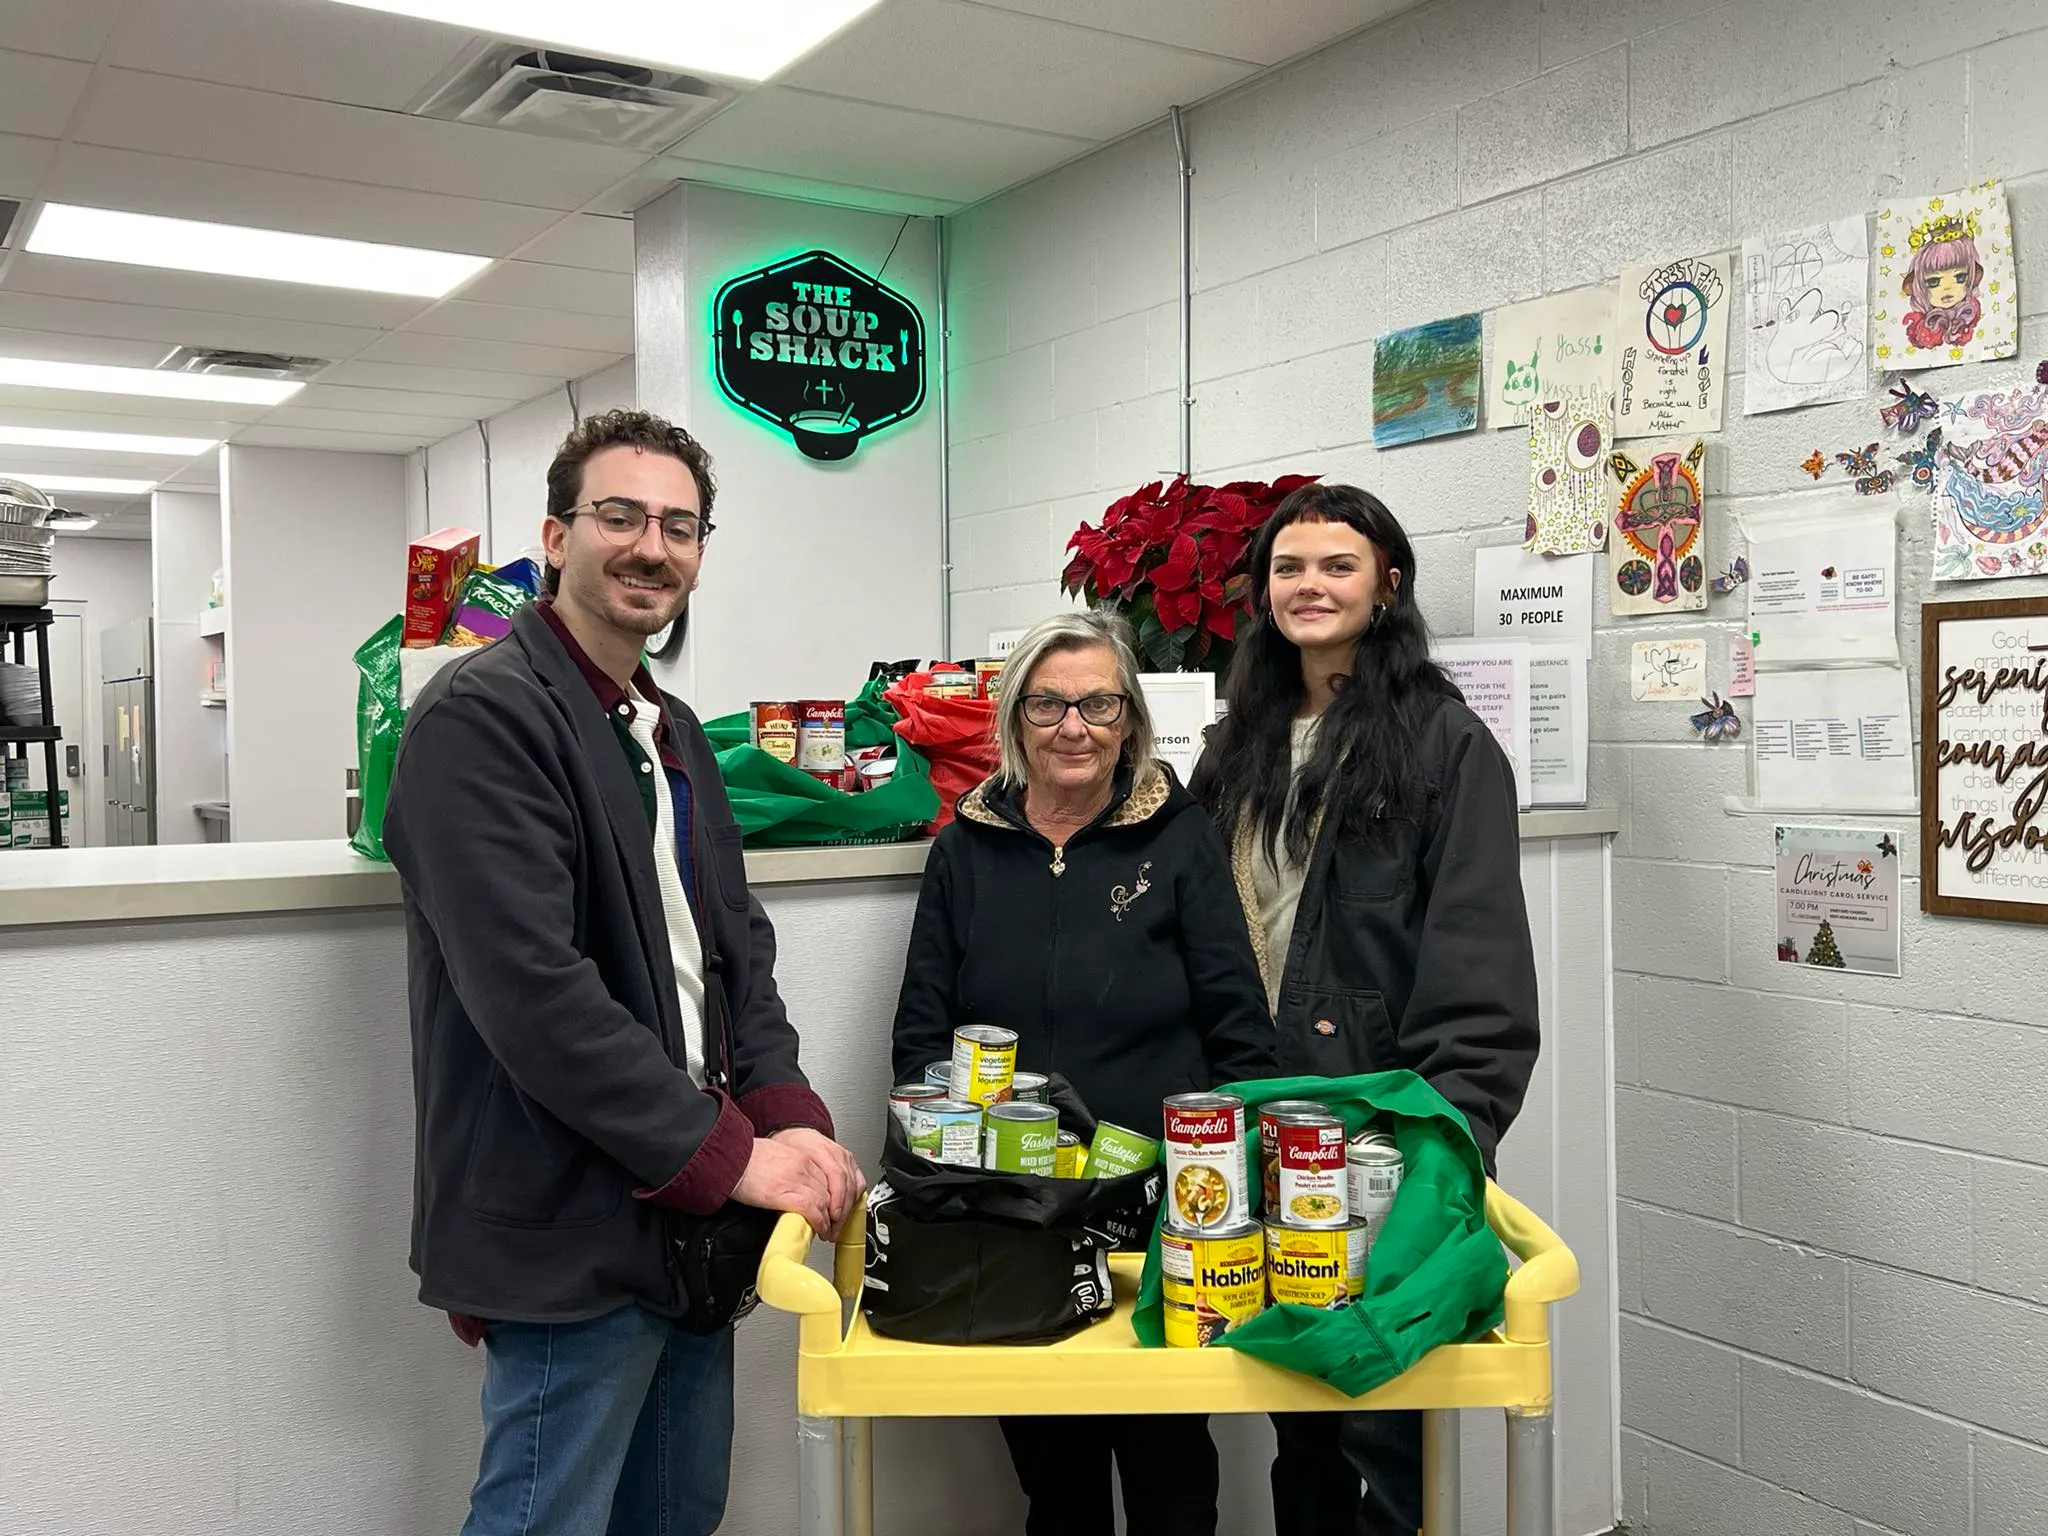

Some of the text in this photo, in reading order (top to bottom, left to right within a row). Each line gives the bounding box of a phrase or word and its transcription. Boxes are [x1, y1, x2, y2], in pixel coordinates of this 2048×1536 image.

[792, 281, 852, 307] THE
[765, 301, 879, 340] SOUP
[749, 331, 896, 373] SHACK
[1659, 387, 1677, 400] right
[1642, 399, 1676, 410] Because
[1500, 585, 1563, 601] MAXIMUM
[1499, 610, 1564, 626] 30 PEOPLE
[1992, 629, 2029, 650] God
[1974, 654, 2015, 669] grant
[1549, 693, 1566, 701] pairs
[1945, 704, 1994, 722] accept
[1999, 700, 2026, 718] the
[769, 722, 789, 730] HEINZ
[1953, 727, 2008, 742] cannot
[1951, 794, 1998, 817] things
[1793, 851, 1876, 890] Christmas
[1780, 887, 1889, 902] CANDLELIGHT CAROL SERVICE
[1806, 903, 1819, 911] PM
[1169, 1116, 1228, 1138] Campbell's
[1100, 1136, 1144, 1165] Tasteful
[1288, 1145, 1339, 1163] Campbell's
[1106, 1220, 1128, 1236] REAL
[1268, 1252, 1341, 1279] Habitant
